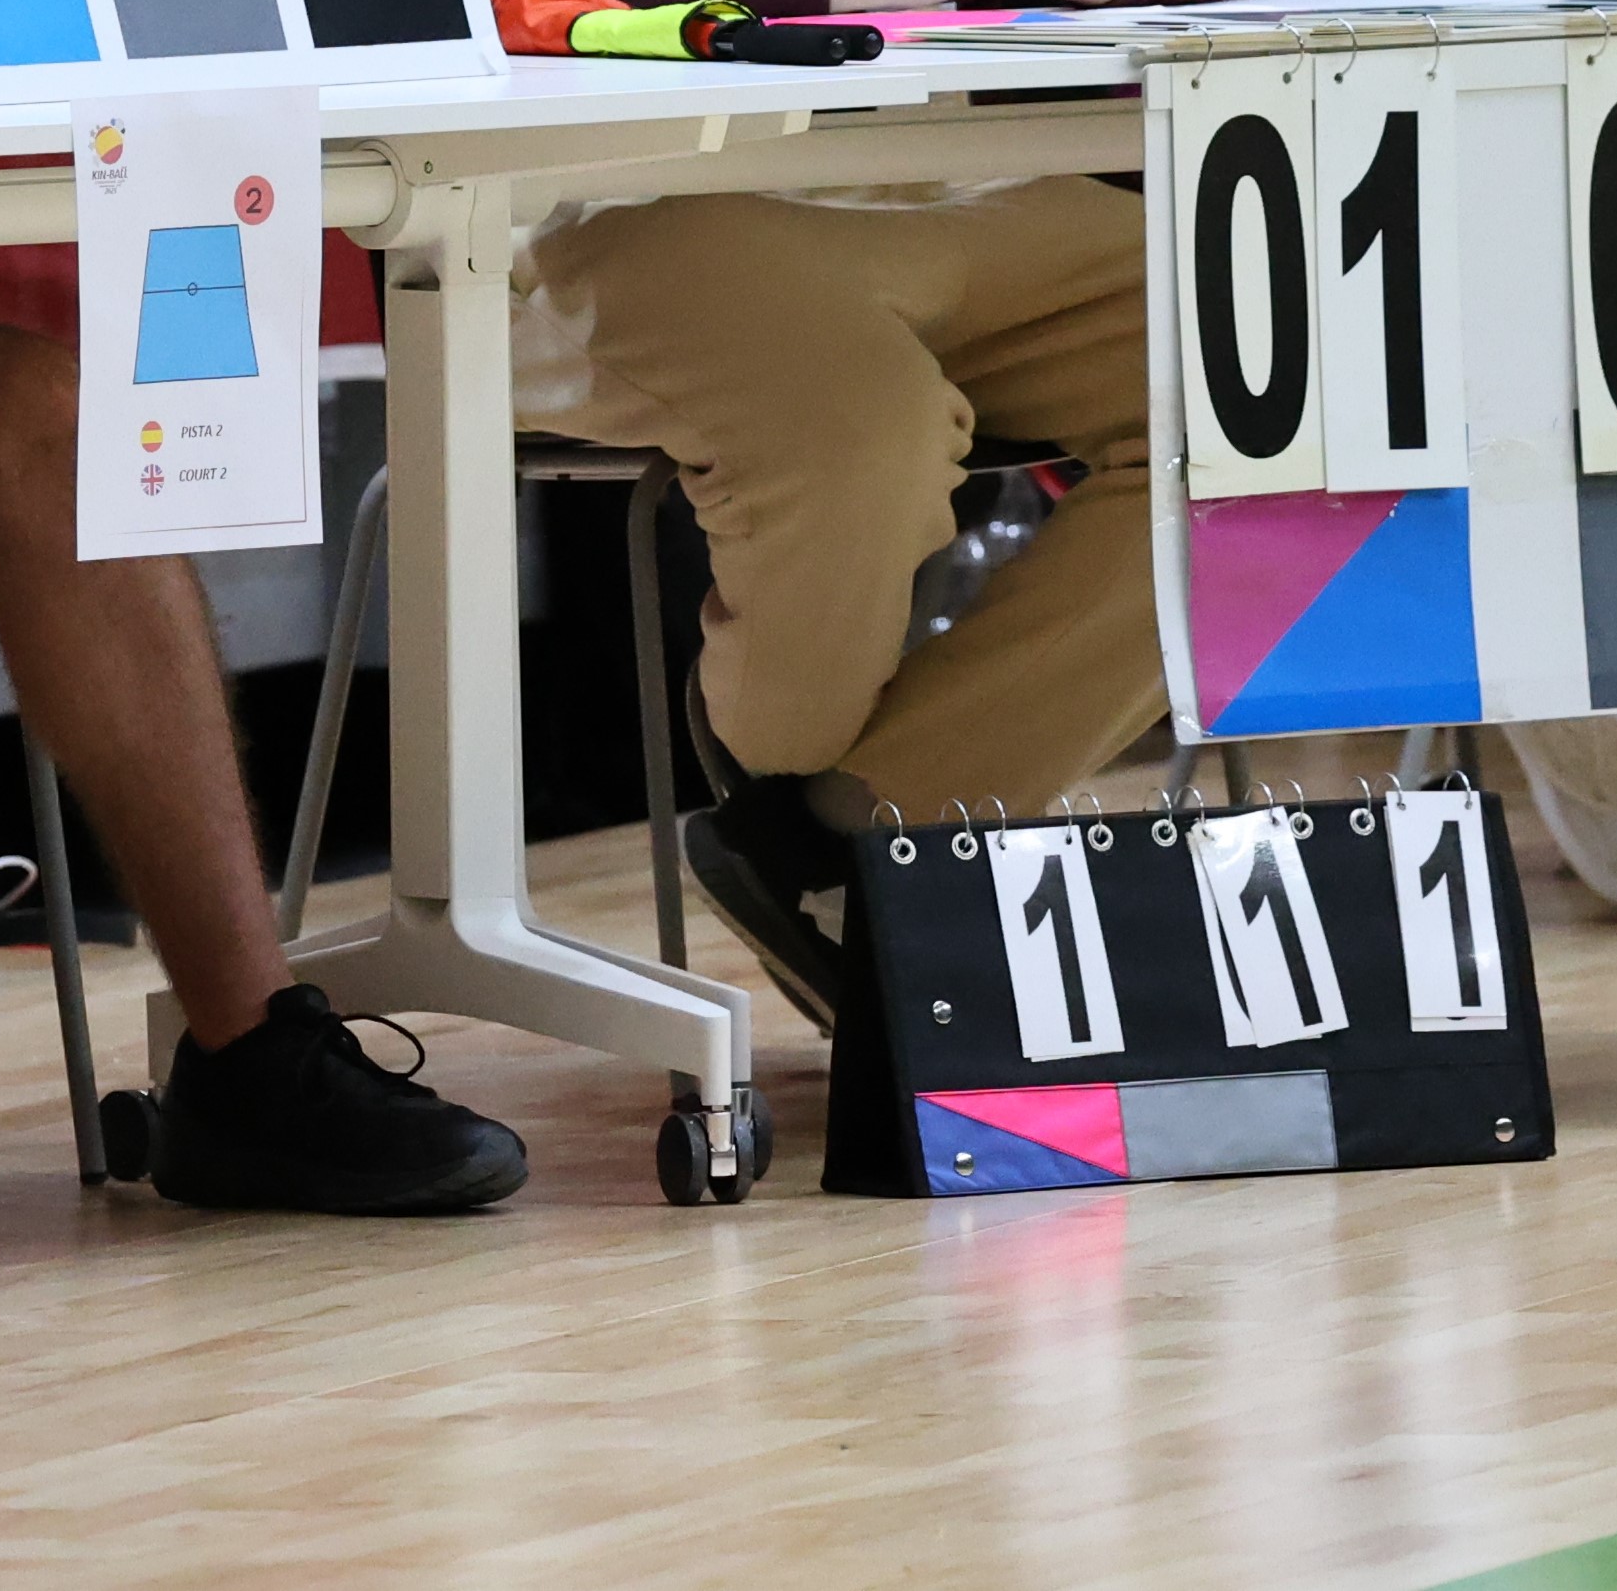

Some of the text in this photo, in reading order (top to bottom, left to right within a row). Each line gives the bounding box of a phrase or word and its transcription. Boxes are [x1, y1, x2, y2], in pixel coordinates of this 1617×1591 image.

[246, 187, 262, 214] 2
[1193, 110, 1428, 460] 01
[181, 424, 223, 439] PISTA 2
[179, 466, 227, 482] COURT 2
[1023, 820, 1481, 1043] 1 1 1
